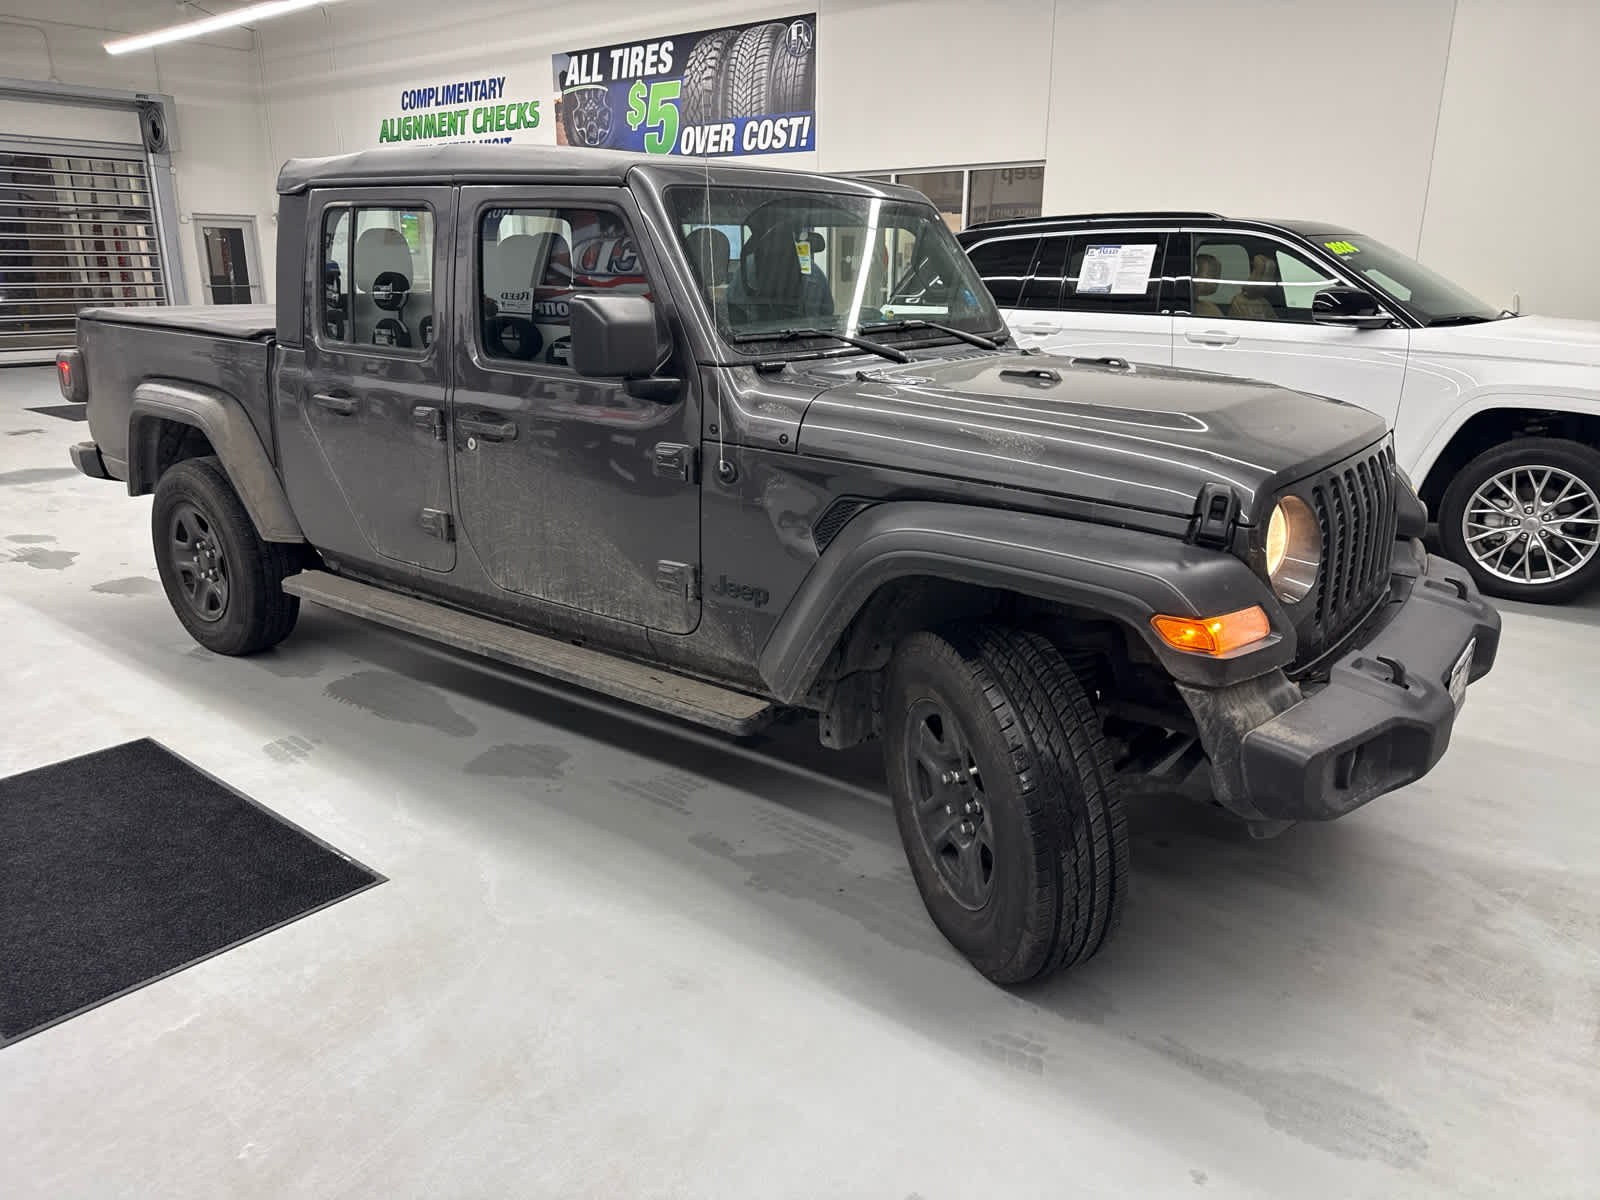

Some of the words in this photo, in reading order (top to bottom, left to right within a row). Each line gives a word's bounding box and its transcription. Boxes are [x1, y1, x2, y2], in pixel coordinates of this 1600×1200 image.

[565, 52, 604, 86] ALL
[610, 40, 674, 81] TIRES
[401, 76, 506, 111] COMPLIMENTARY
[379, 108, 470, 143] ALIGNMENT
[472, 100, 540, 134] CHECKS
[626, 79, 682, 155] $5
[680, 122, 736, 155] OVER
[742, 115, 811, 151] COST!
[711, 574, 769, 608] Jeep
